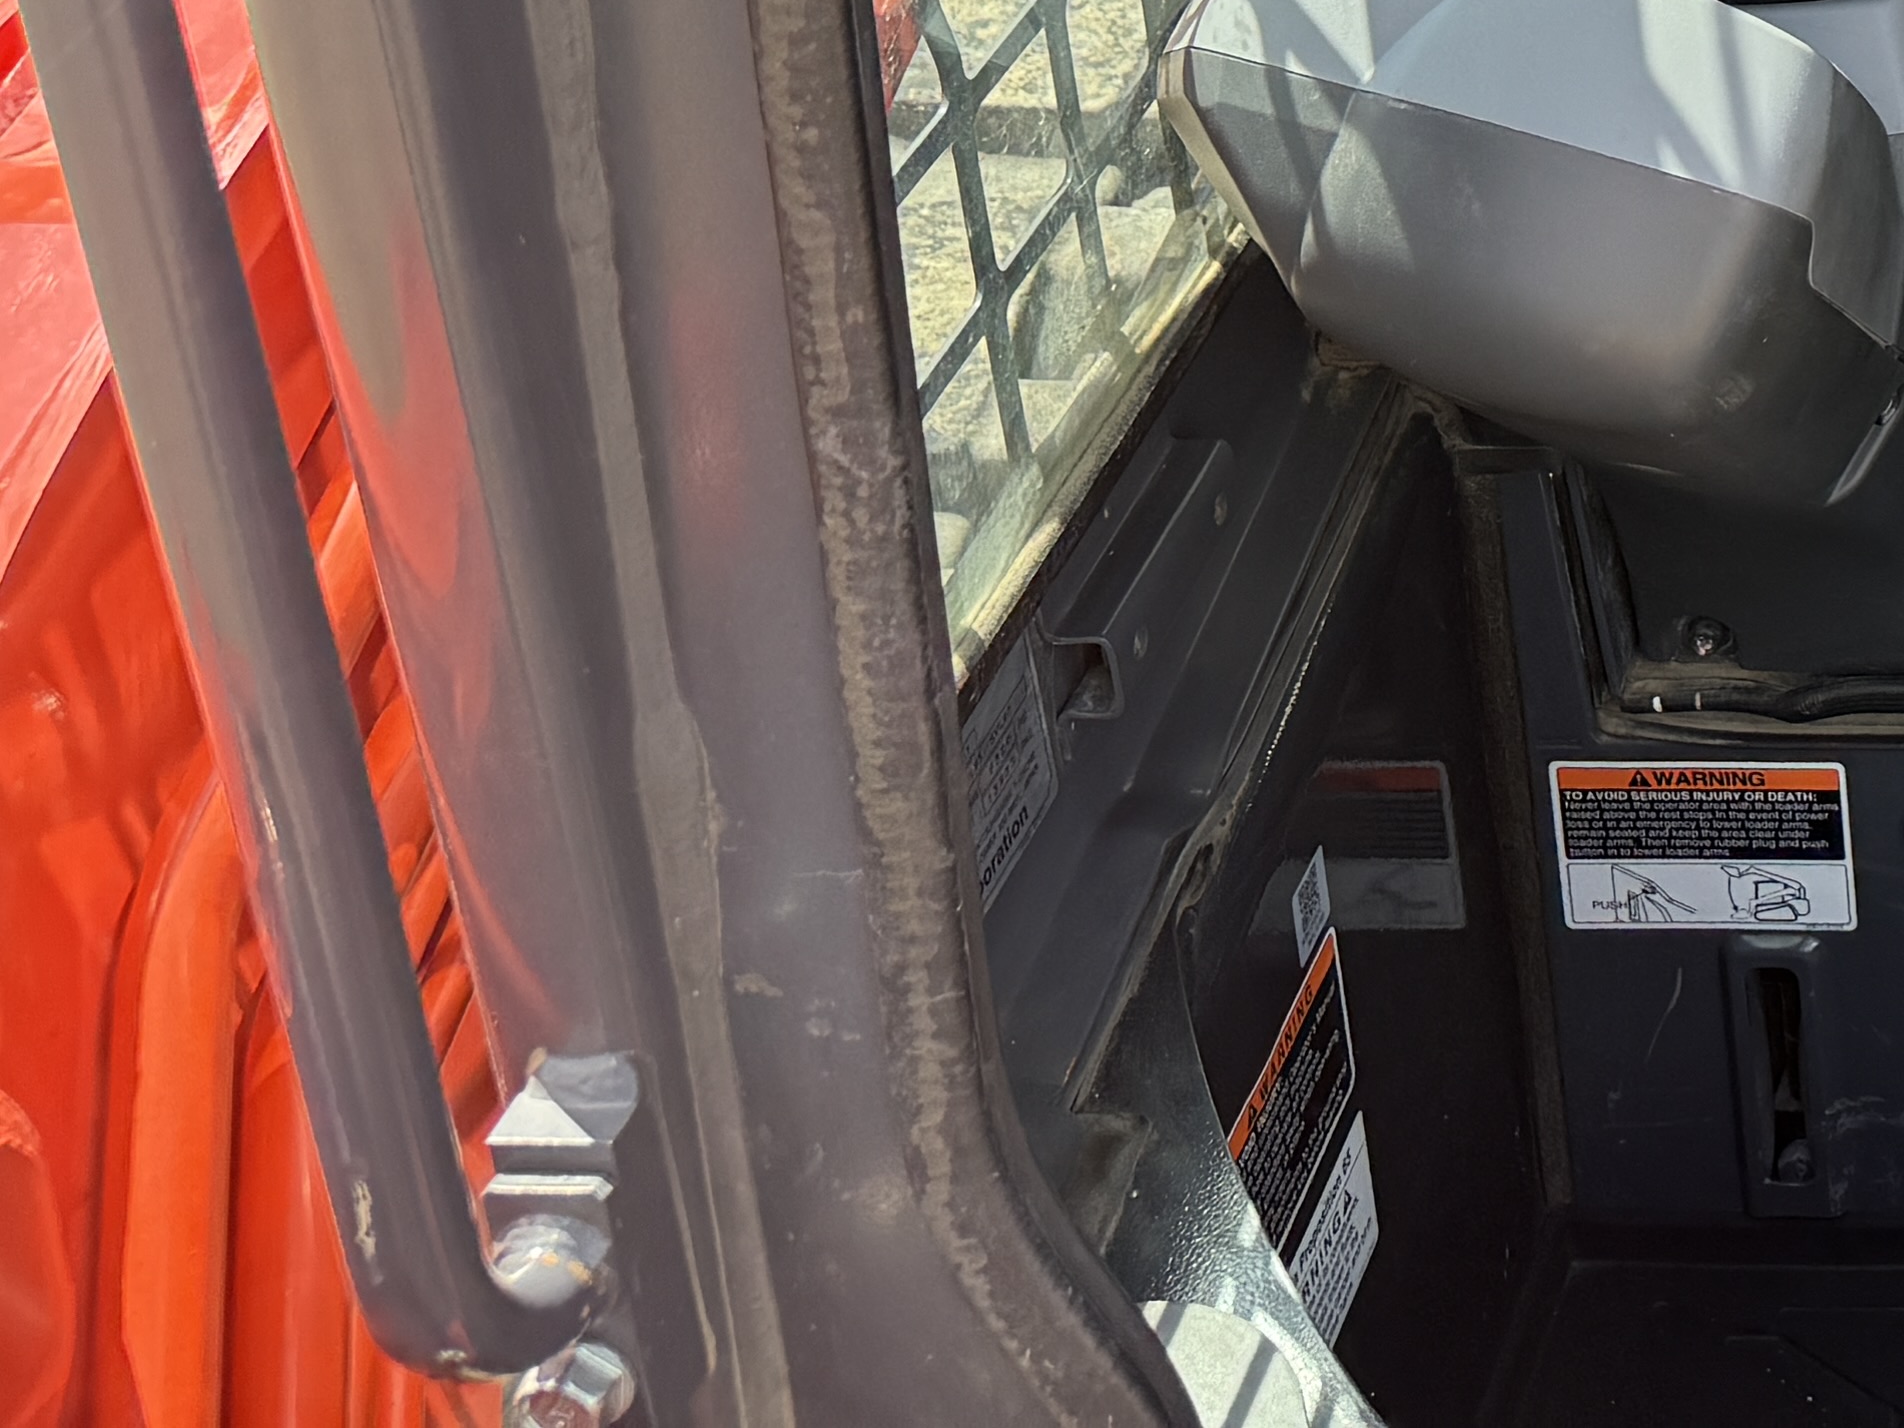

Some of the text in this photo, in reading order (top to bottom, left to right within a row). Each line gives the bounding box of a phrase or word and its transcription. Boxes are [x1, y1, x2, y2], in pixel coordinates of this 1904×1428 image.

[1652, 771, 1766, 787] WARNING
[1586, 791, 1628, 801] AVOID
[1631, 791, 1690, 801] SERIOUS
[1693, 792, 1740, 801] INJURY
[1768, 792, 1817, 801] DEATH:
[1600, 802, 1630, 810] leave
[1654, 802, 1700, 811] operator
[1730, 802, 1752, 810] with
[1775, 802, 1808, 810] loader
[1603, 811, 1636, 819] above
[1795, 813, 1829, 821] power
[1568, 830, 1606, 838] remain
[1609, 830, 1646, 838] seated
[1672, 830, 1698, 839] keep
[1749, 830, 1775, 838] clear
[1778, 830, 1810, 838] under
[1568, 839, 1603, 847] loader
[1640, 839, 1668, 847] Then
[1715, 839, 1749, 847] rubber
[1752, 839, 1776, 848] plug
[1802, 839, 1829, 849] push
[1634, 848, 1662, 856] lower
[1666, 848, 1699, 856] loader
[1592, 900, 1628, 910] PUSH
[1258, 983, 1313, 1101] WARNING
[1300, 1175, 1342, 1273] Proposition
